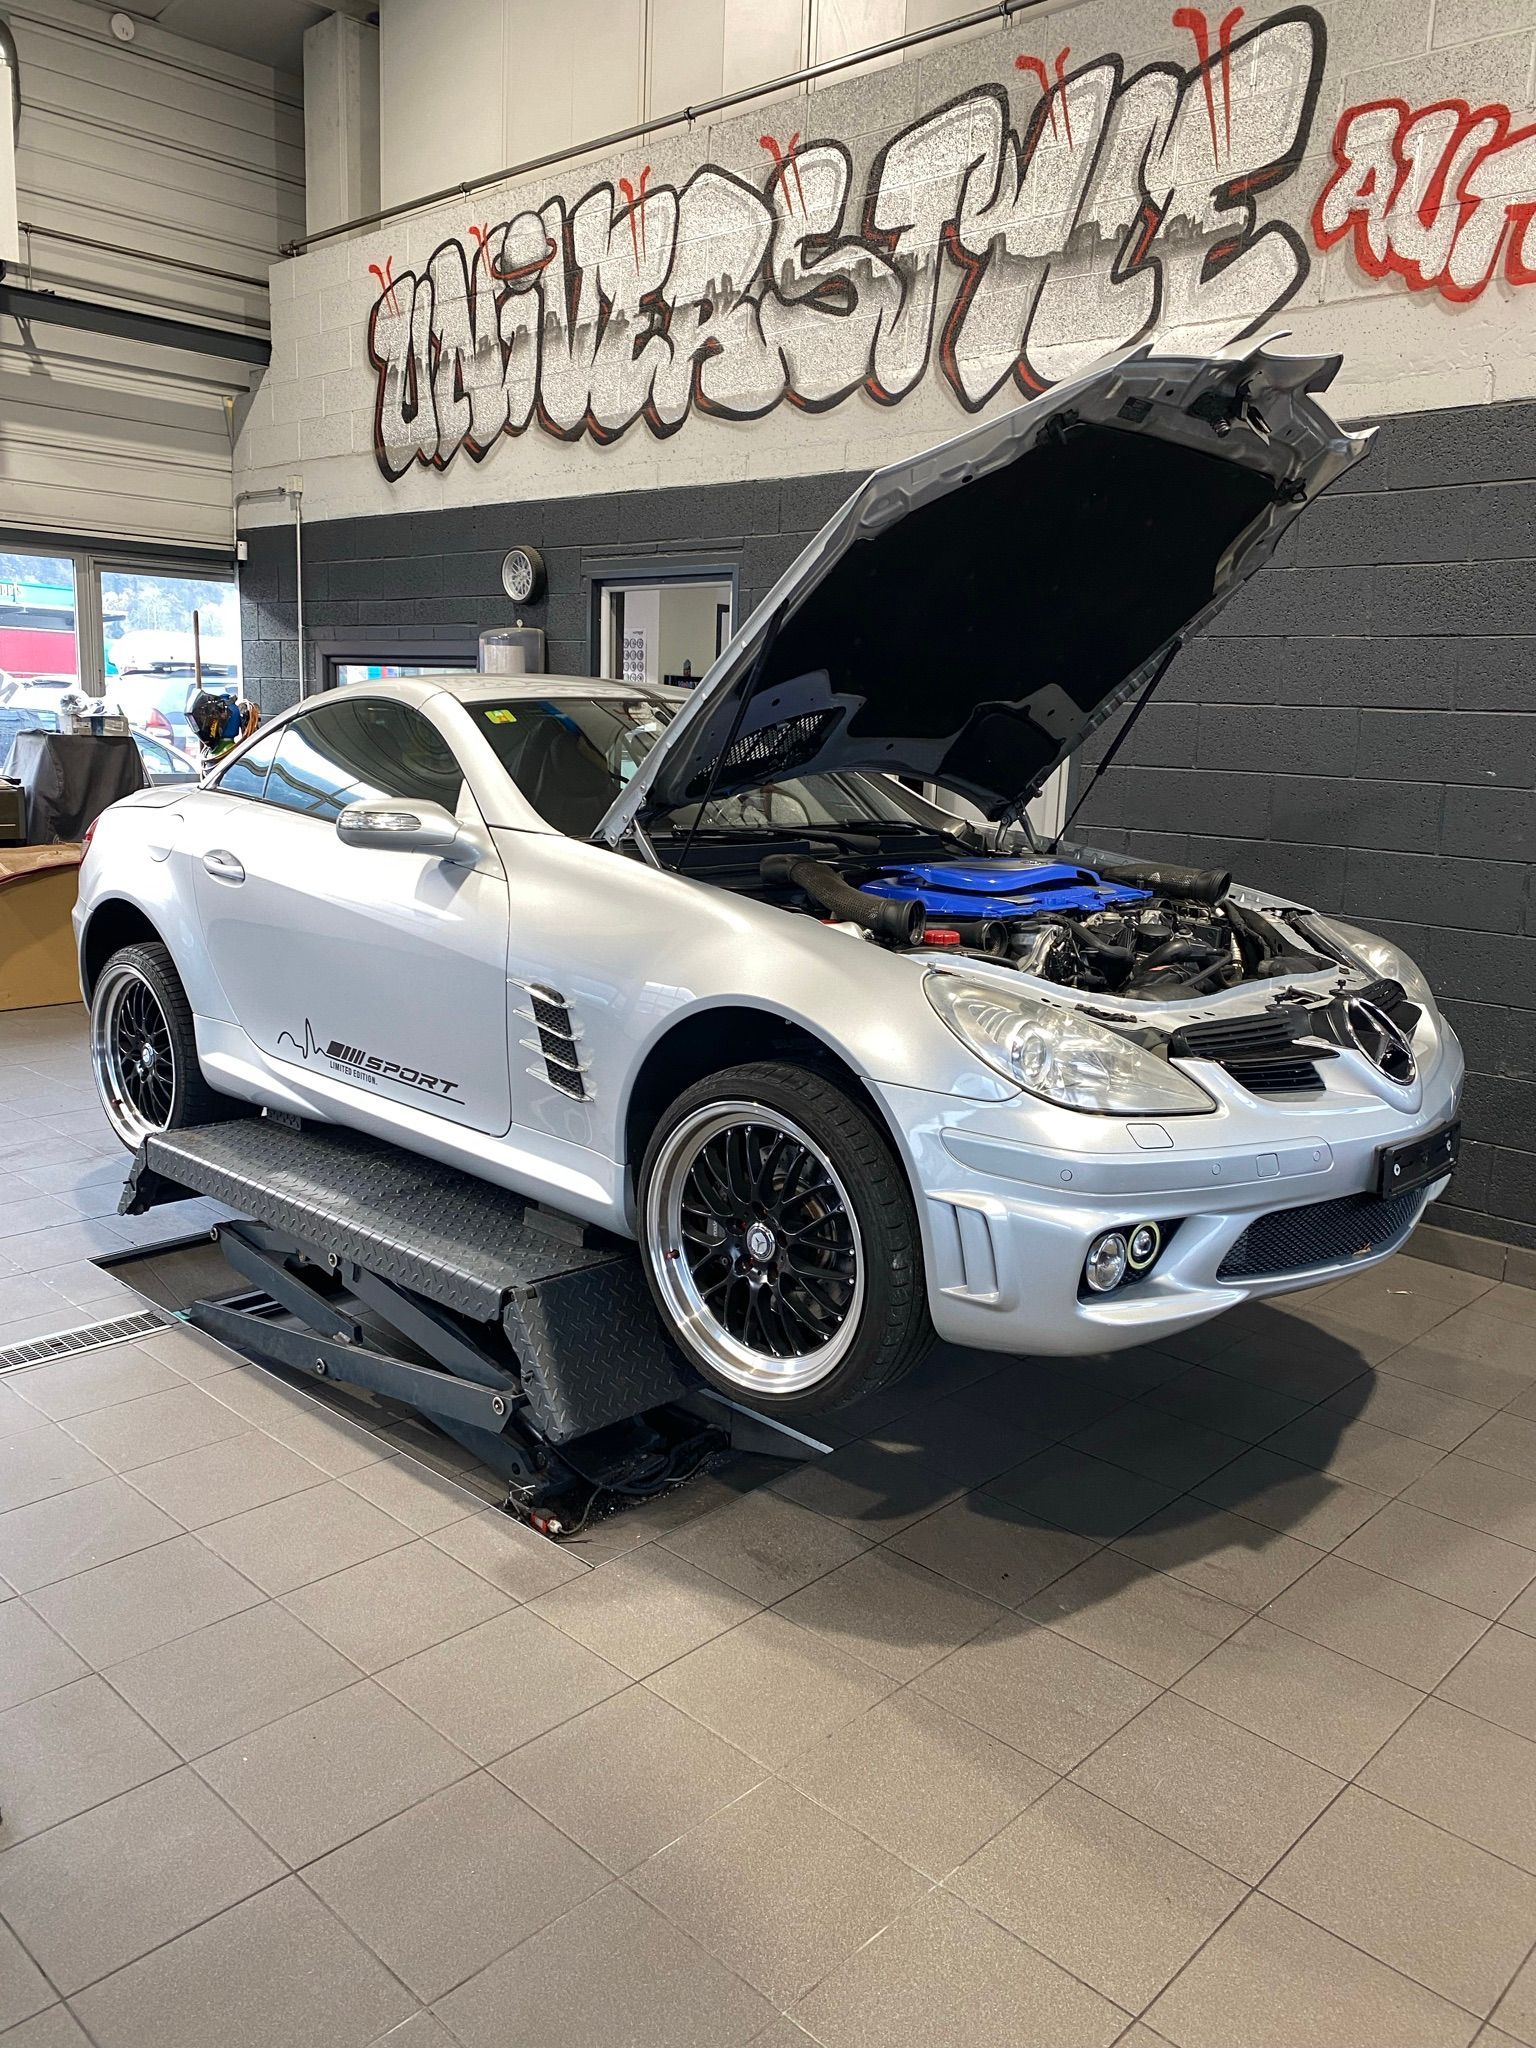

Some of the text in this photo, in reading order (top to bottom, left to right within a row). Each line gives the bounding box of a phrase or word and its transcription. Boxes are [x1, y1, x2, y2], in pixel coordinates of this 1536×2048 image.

[1311, 97, 1536, 302] AUT
[329, 1060, 352, 1075] LIMITED
[365, 1055, 458, 1094] SPORT
